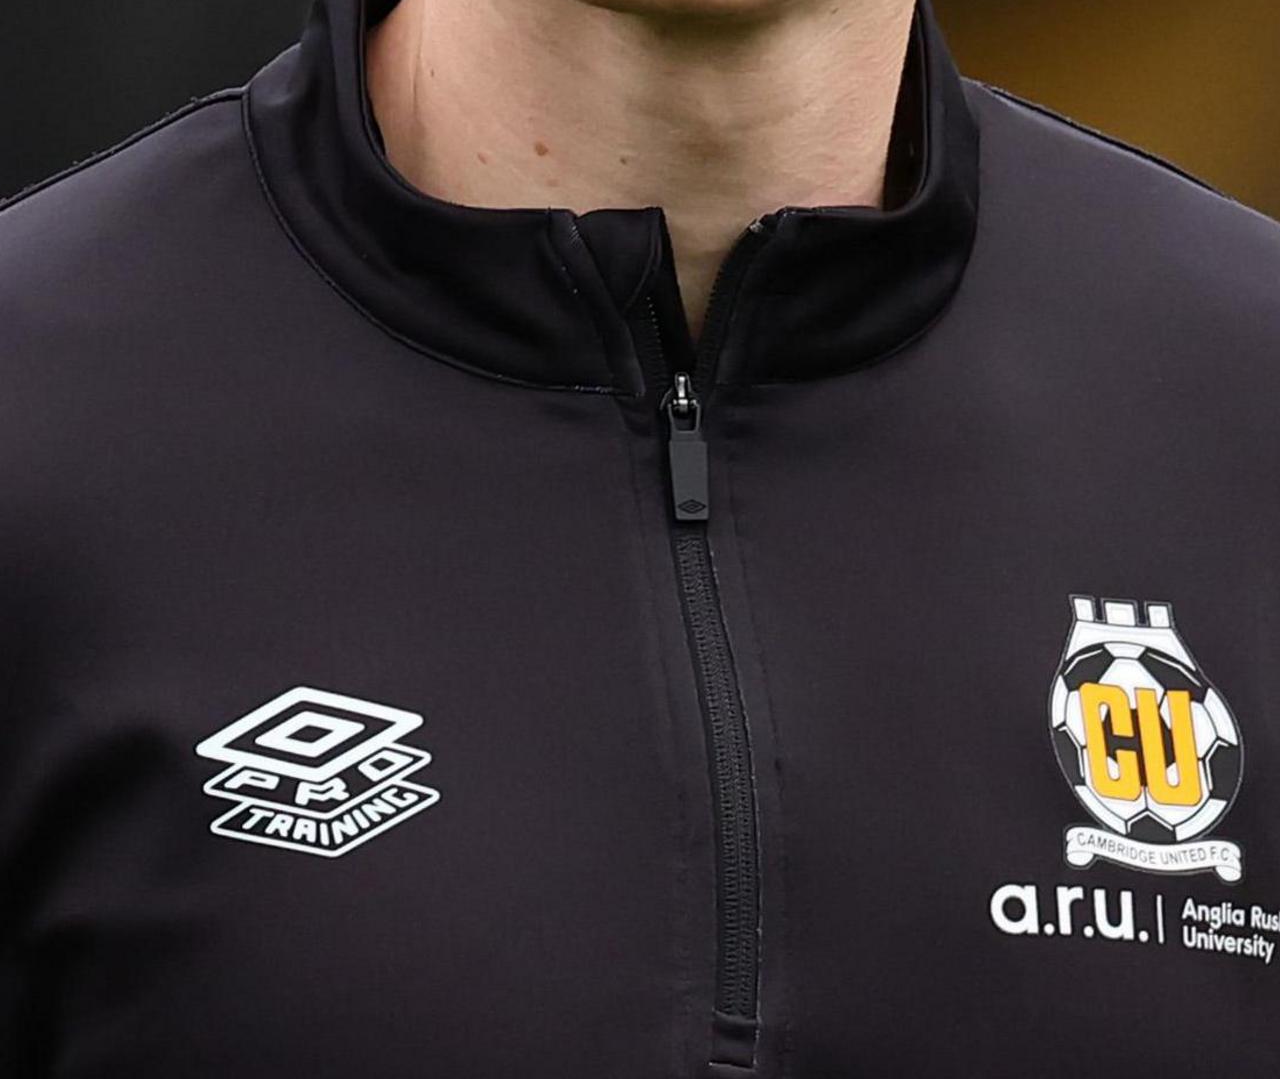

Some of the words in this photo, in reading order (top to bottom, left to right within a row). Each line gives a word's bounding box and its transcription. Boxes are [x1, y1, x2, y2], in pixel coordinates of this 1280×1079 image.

[1079, 682, 1203, 806] CU
[224, 749, 414, 805] PRO
[241, 787, 419, 845] TRAINING
[1077, 832, 1156, 864] CAMBRIDGE
[1159, 847, 1208, 865] UNITED
[990, 883, 1149, 942] a.r.u.
[1182, 897, 1246, 930] Anglia
[1182, 924, 1275, 964] University
